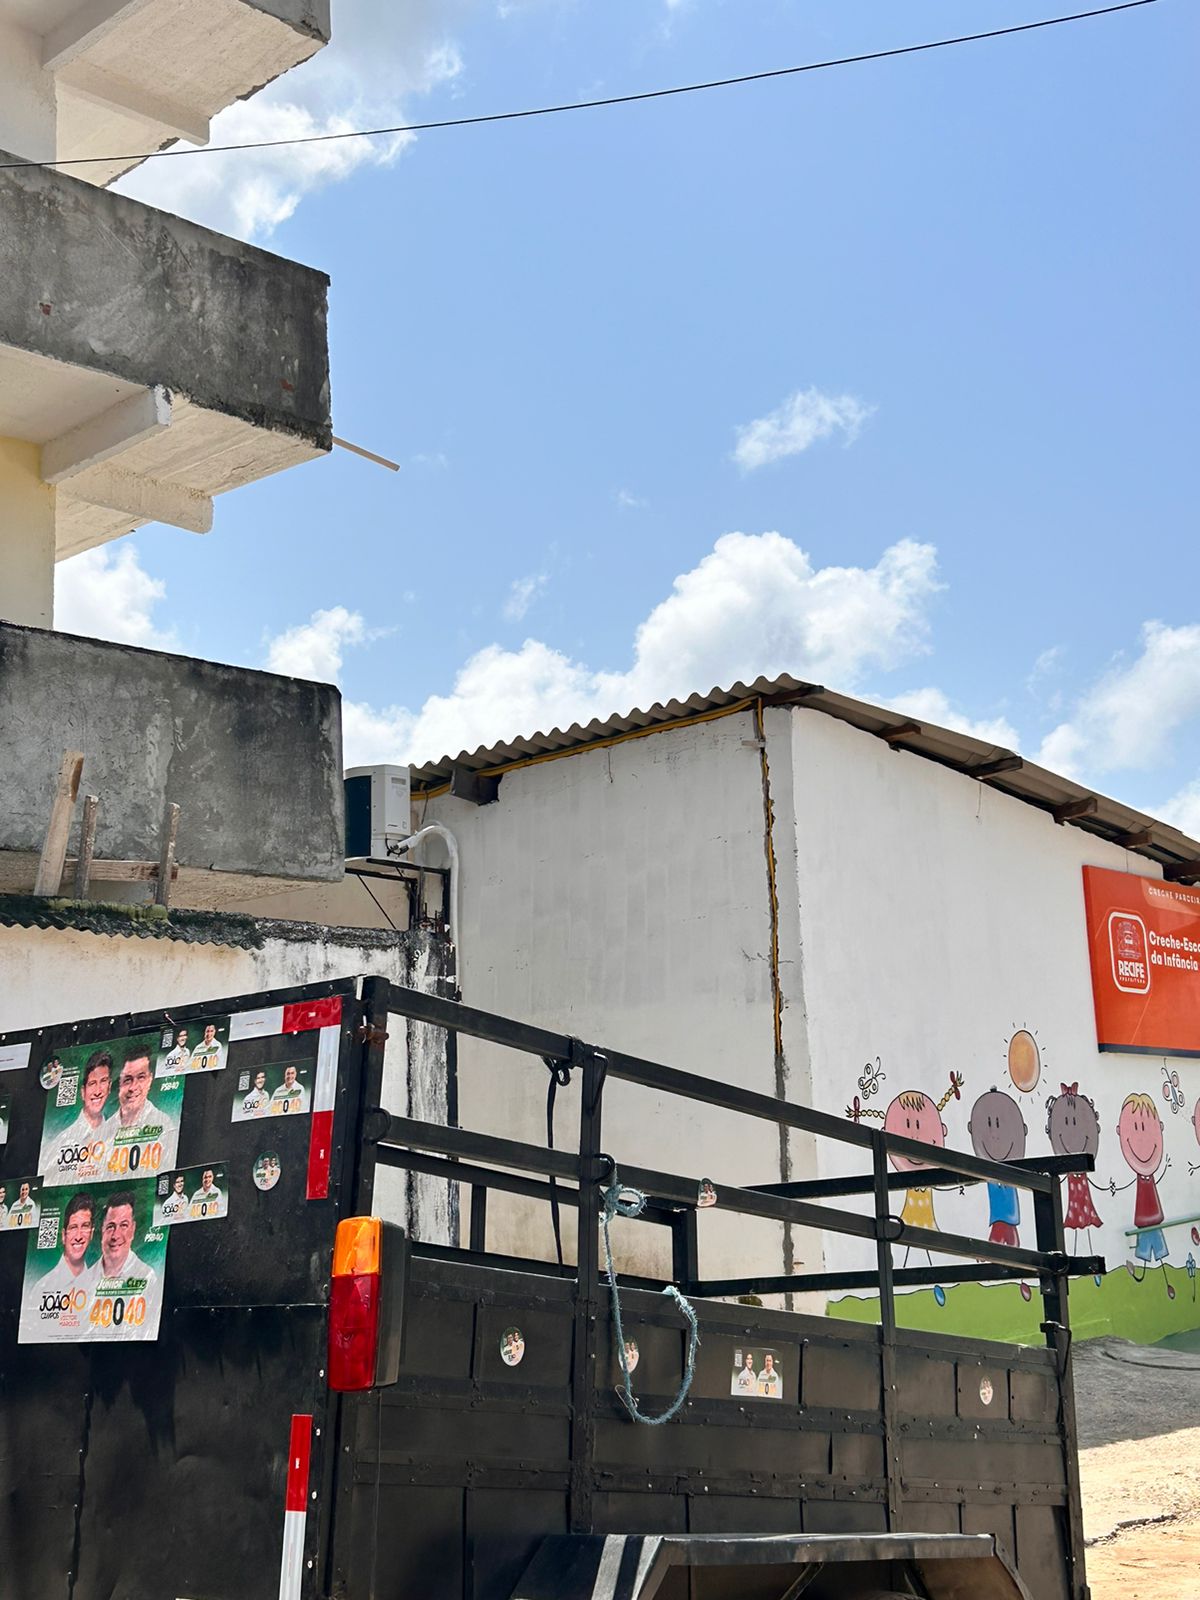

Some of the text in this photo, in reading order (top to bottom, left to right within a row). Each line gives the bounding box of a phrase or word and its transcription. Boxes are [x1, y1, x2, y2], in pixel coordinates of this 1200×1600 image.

[1118, 960, 1145, 978] RECIFE
[1151, 950, 1199, 971] da Infância
[57, 1143, 89, 1165] JOÃO
[108, 1142, 162, 1175] 40040
[39, 1290, 70, 1312] JOÃO
[89, 1296, 147, 1328] 40040
